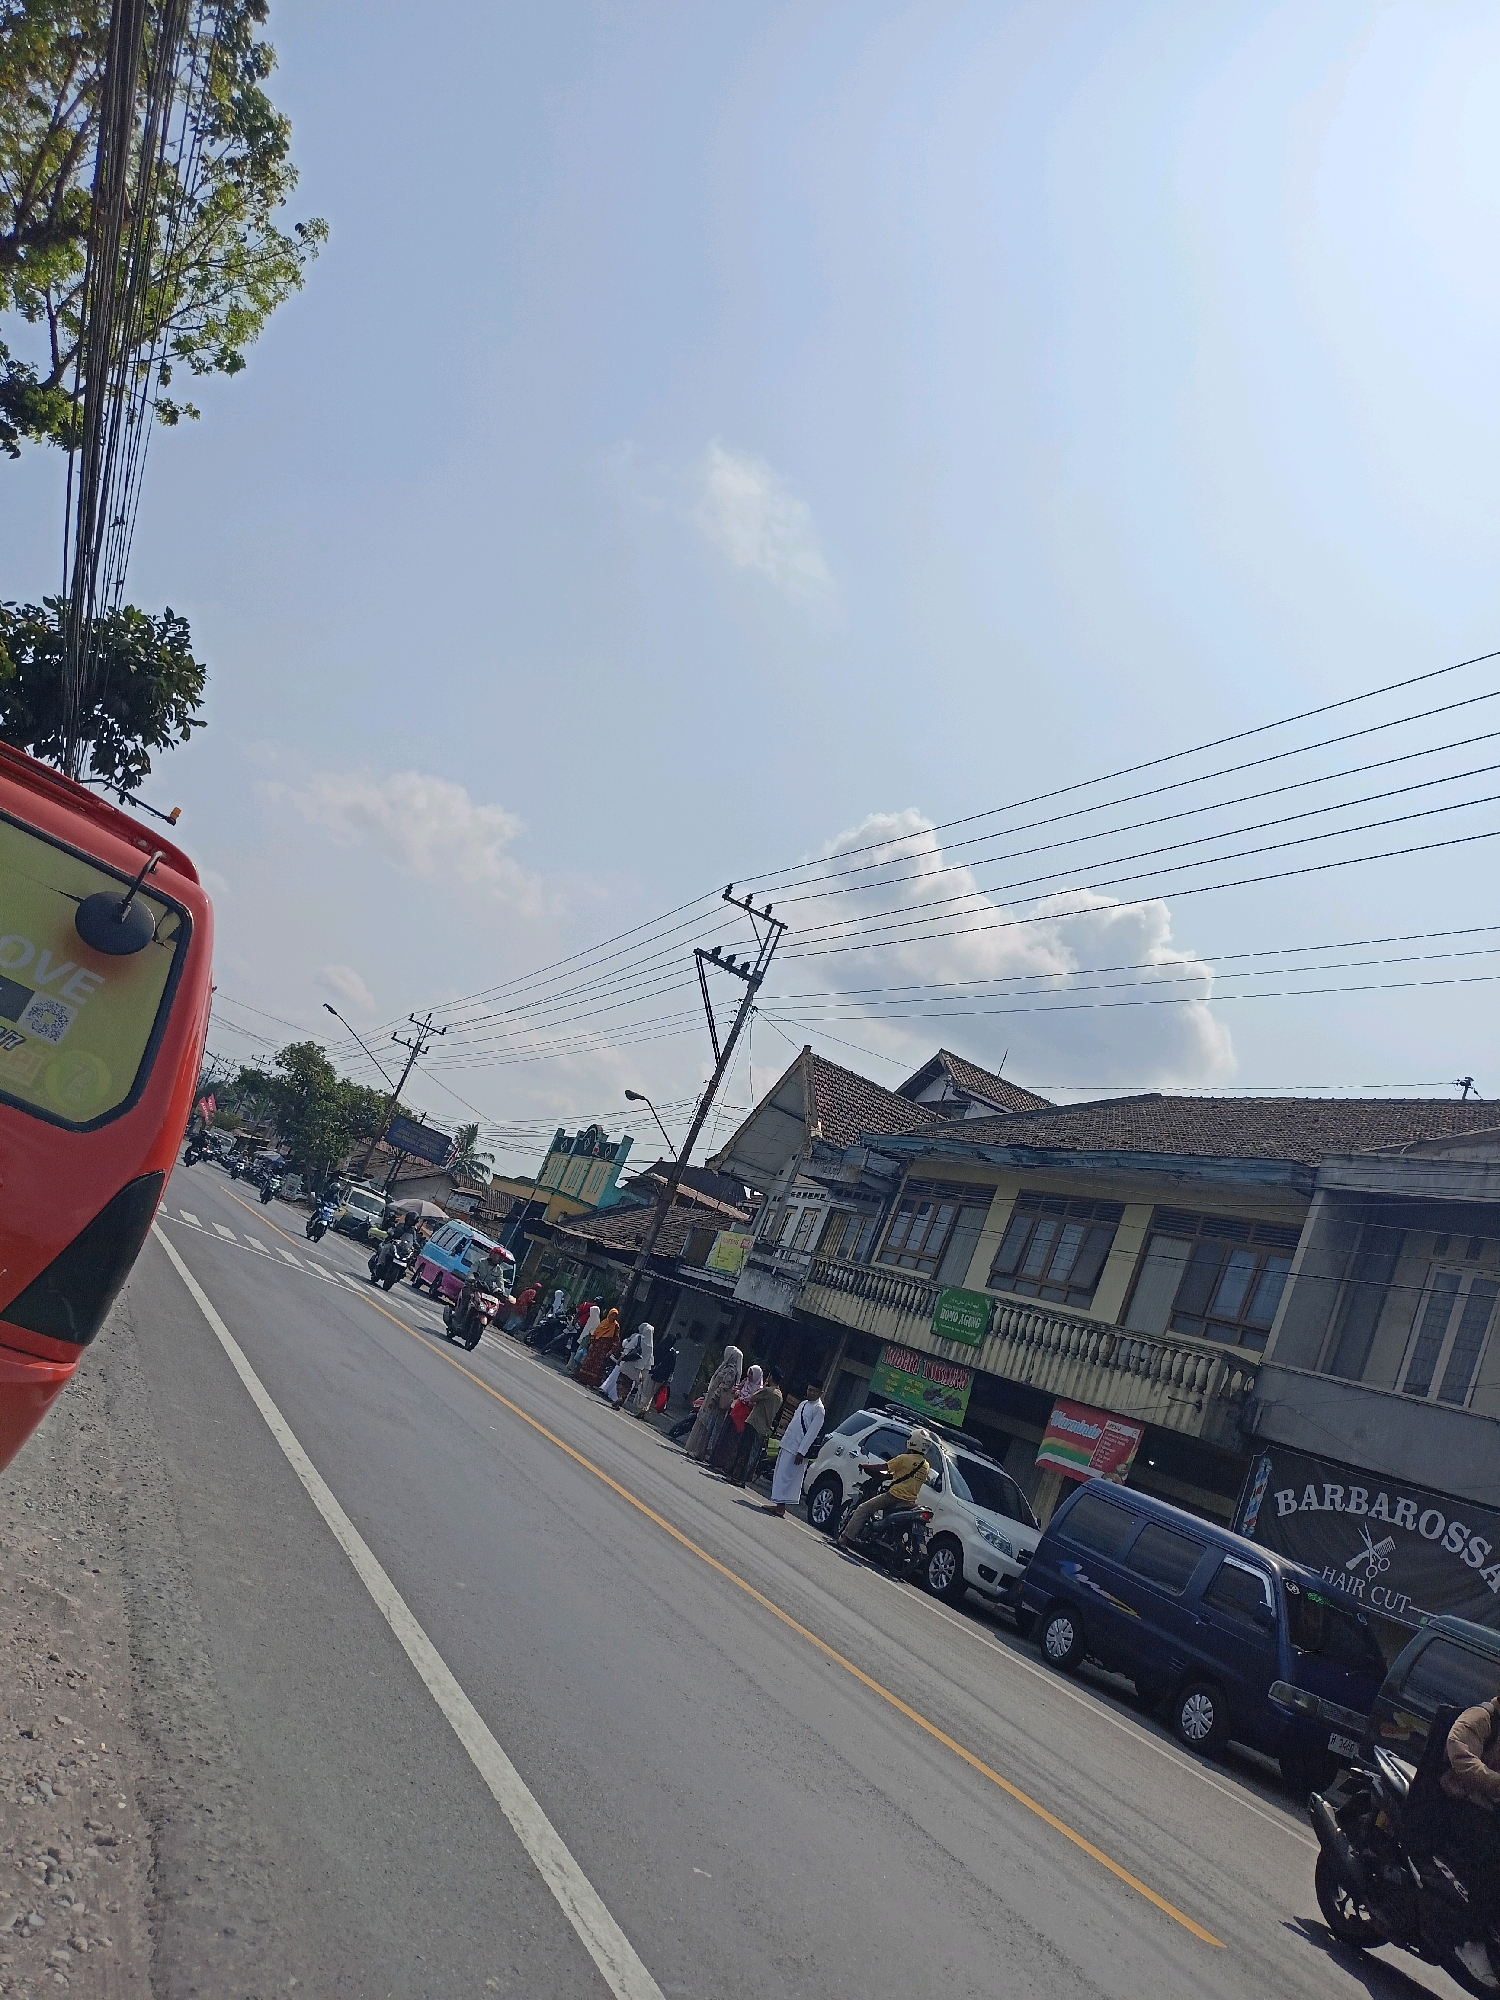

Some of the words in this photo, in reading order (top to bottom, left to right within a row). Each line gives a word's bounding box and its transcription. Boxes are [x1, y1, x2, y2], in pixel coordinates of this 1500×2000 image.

[1050, 1410, 1102, 1440] Warmindo
[1321, 1565, 1367, 1599] HAIR
[1370, 1586, 1412, 1614] CUT
